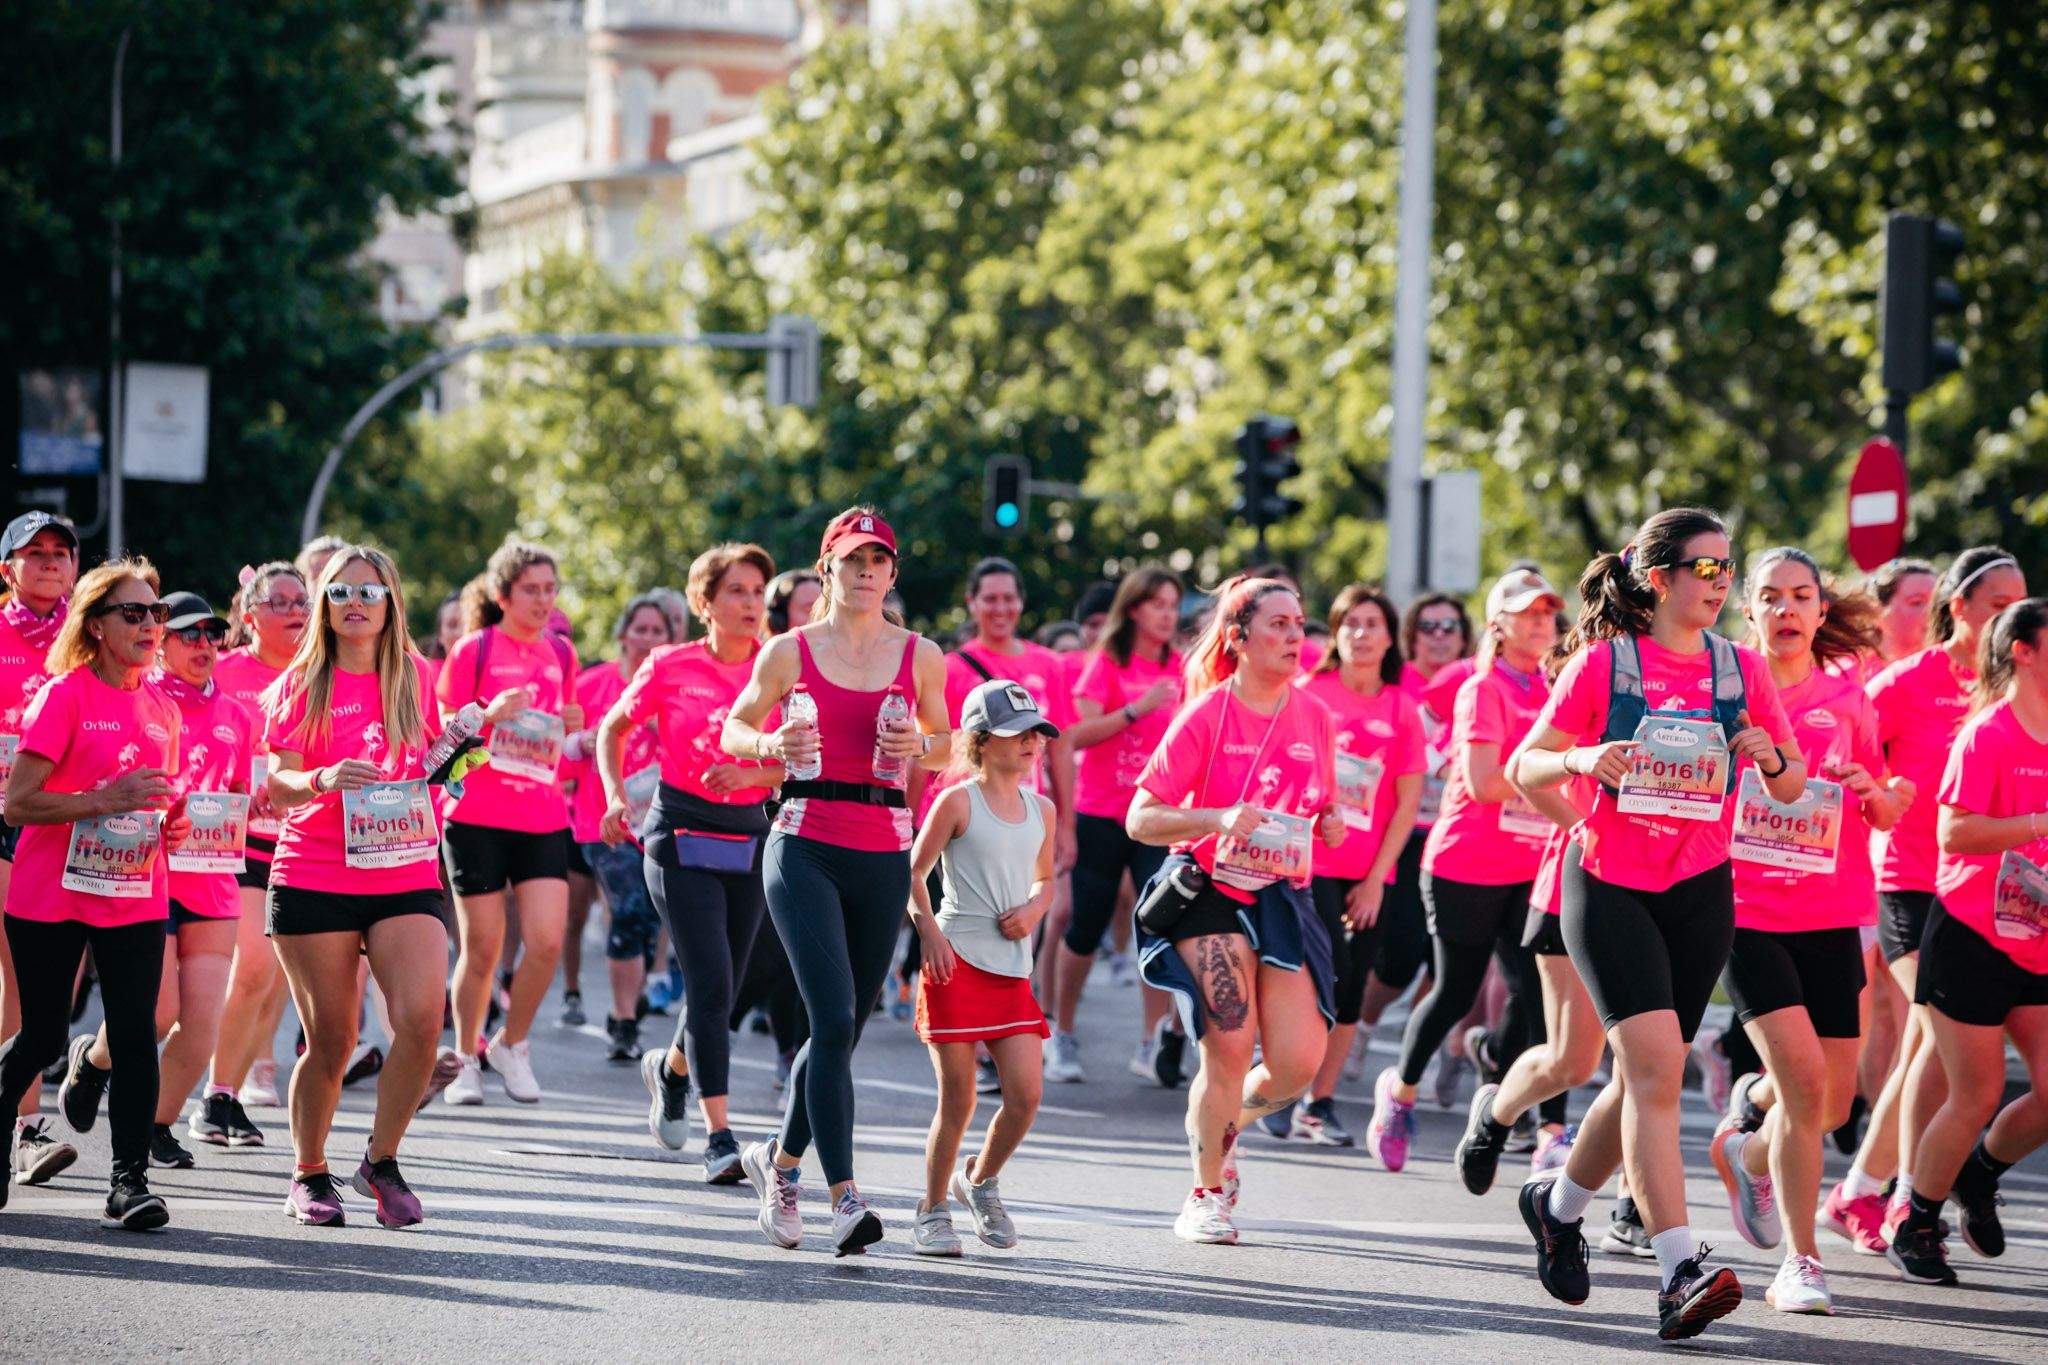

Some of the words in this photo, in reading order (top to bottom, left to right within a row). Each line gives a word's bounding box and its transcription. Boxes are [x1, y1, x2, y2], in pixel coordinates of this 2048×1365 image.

[0, 655, 26, 665] SHO
[1642, 680, 1667, 692] SHO
[331, 702, 363, 719] YSHO
[82, 720, 121, 732] OYSHO
[1652, 760, 1694, 779] 016
[376, 816, 410, 835] 016
[1769, 814, 1809, 834] 016
[192, 826, 222, 841] 016
[102, 846, 137, 865] 016
[1249, 845, 1284, 865] 016
